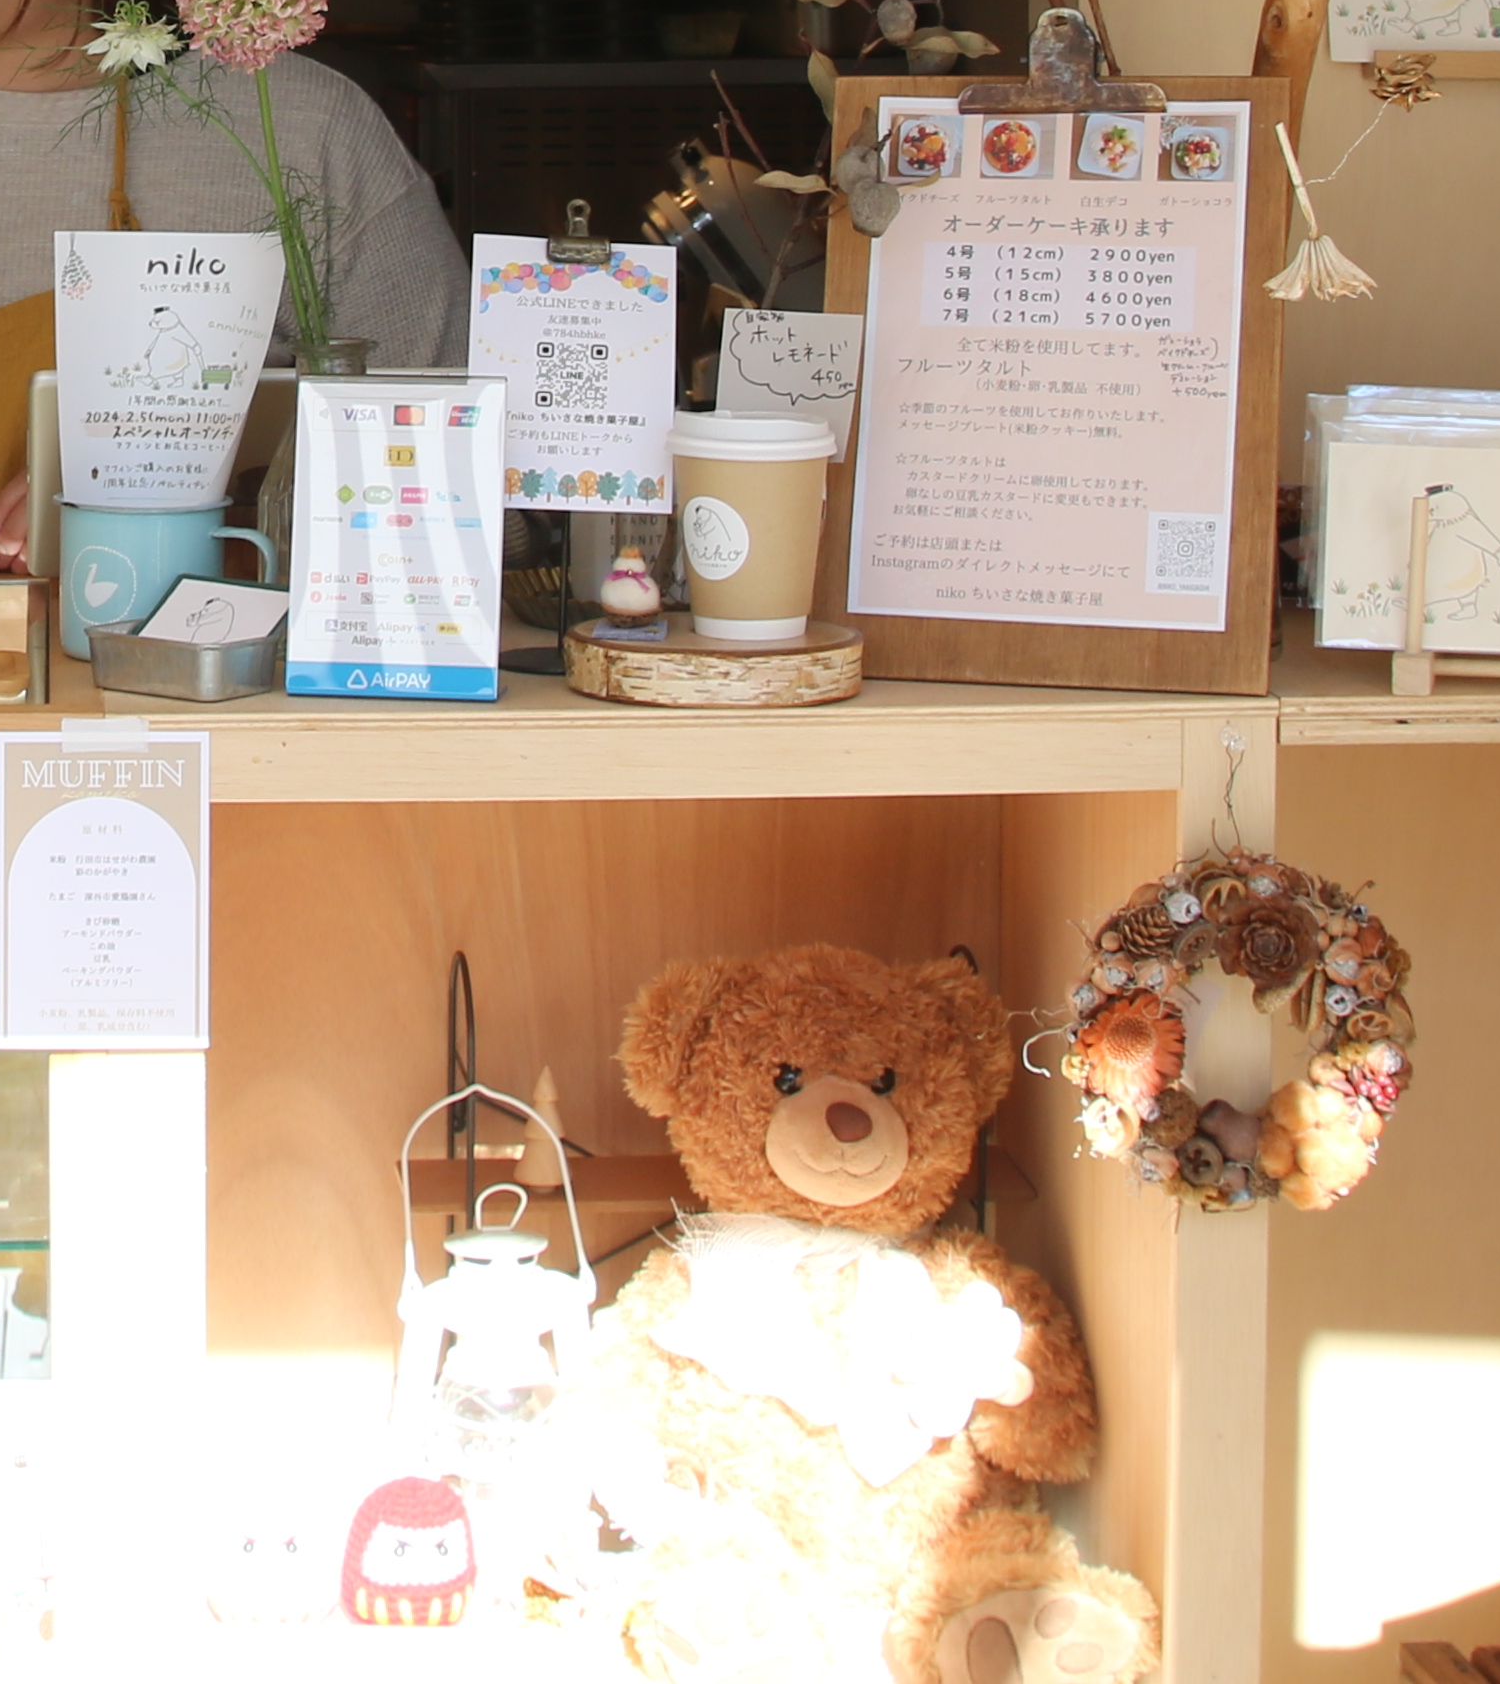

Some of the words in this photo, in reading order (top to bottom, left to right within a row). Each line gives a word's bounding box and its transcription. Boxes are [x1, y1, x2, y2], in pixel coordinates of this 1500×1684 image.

[900, 193, 959, 204] イクドチーズ
[975, 194, 1052, 206] フルーツタルト
[1081, 196, 1128, 208] 白生デコ
[1159, 196, 1233, 208] ガトーショコラ
[942, 216, 1175, 239] オーダーケーキ承ります
[146, 247, 226, 275] niko
[946, 246, 975, 260] 4号
[1089, 249, 1175, 265] 2900yen
[944, 266, 972, 281] 5号
[1087, 270, 1173, 286] 3800yen
[140, 282, 232, 294] ちいさな焼き菓子屋
[516, 295, 643, 313] 公式LINEできました
[943, 287, 971, 302] 6号
[1085, 291, 1172, 308] 4600yen
[548, 314, 602, 325] 友達募集中
[942, 308, 970, 323] 7号
[1084, 312, 1171, 330] 5700yen
[750, 325, 796, 345] ホット
[772, 341, 849, 364] レモネード
[956, 336, 1141, 359] 全て米粉を使用してます。
[898, 358, 1032, 378] フルーツタルト
[560, 371, 584, 380] LINE
[810, 369, 842, 387] 450
[86, 411, 191, 423] 2024.2.5(mon)
[342, 407, 378, 422] VISA
[507, 429, 633, 444] ご予約もLINEトークから
[536, 445, 603, 457] お願いします
[873, 534, 1002, 554] ご予約は店頭または
[689, 543, 743, 562] niko
[870, 554, 1131, 580] Instagramのダイレクトメッセージにて
[935, 586, 966, 600] niko
[972, 587, 1104, 607] ちいさな焼き菓子屋
[339, 620, 368, 632] 支付宝
[376, 621, 413, 634] Alipay
[351, 635, 384, 647] Alipay
[21, 759, 186, 789] MUFFIN
[81, 824, 124, 835] 原材料
[48, 855, 67, 865] 米粉
[48, 891, 76, 902] たまご
[85, 917, 121, 927] きび砂糖
[61, 929, 142, 939] アーモンドパウダー
[89, 941, 116, 951] こめ油
[93, 954, 111, 964] 豆乳
[61, 965, 142, 976] ベーキングパウダー
